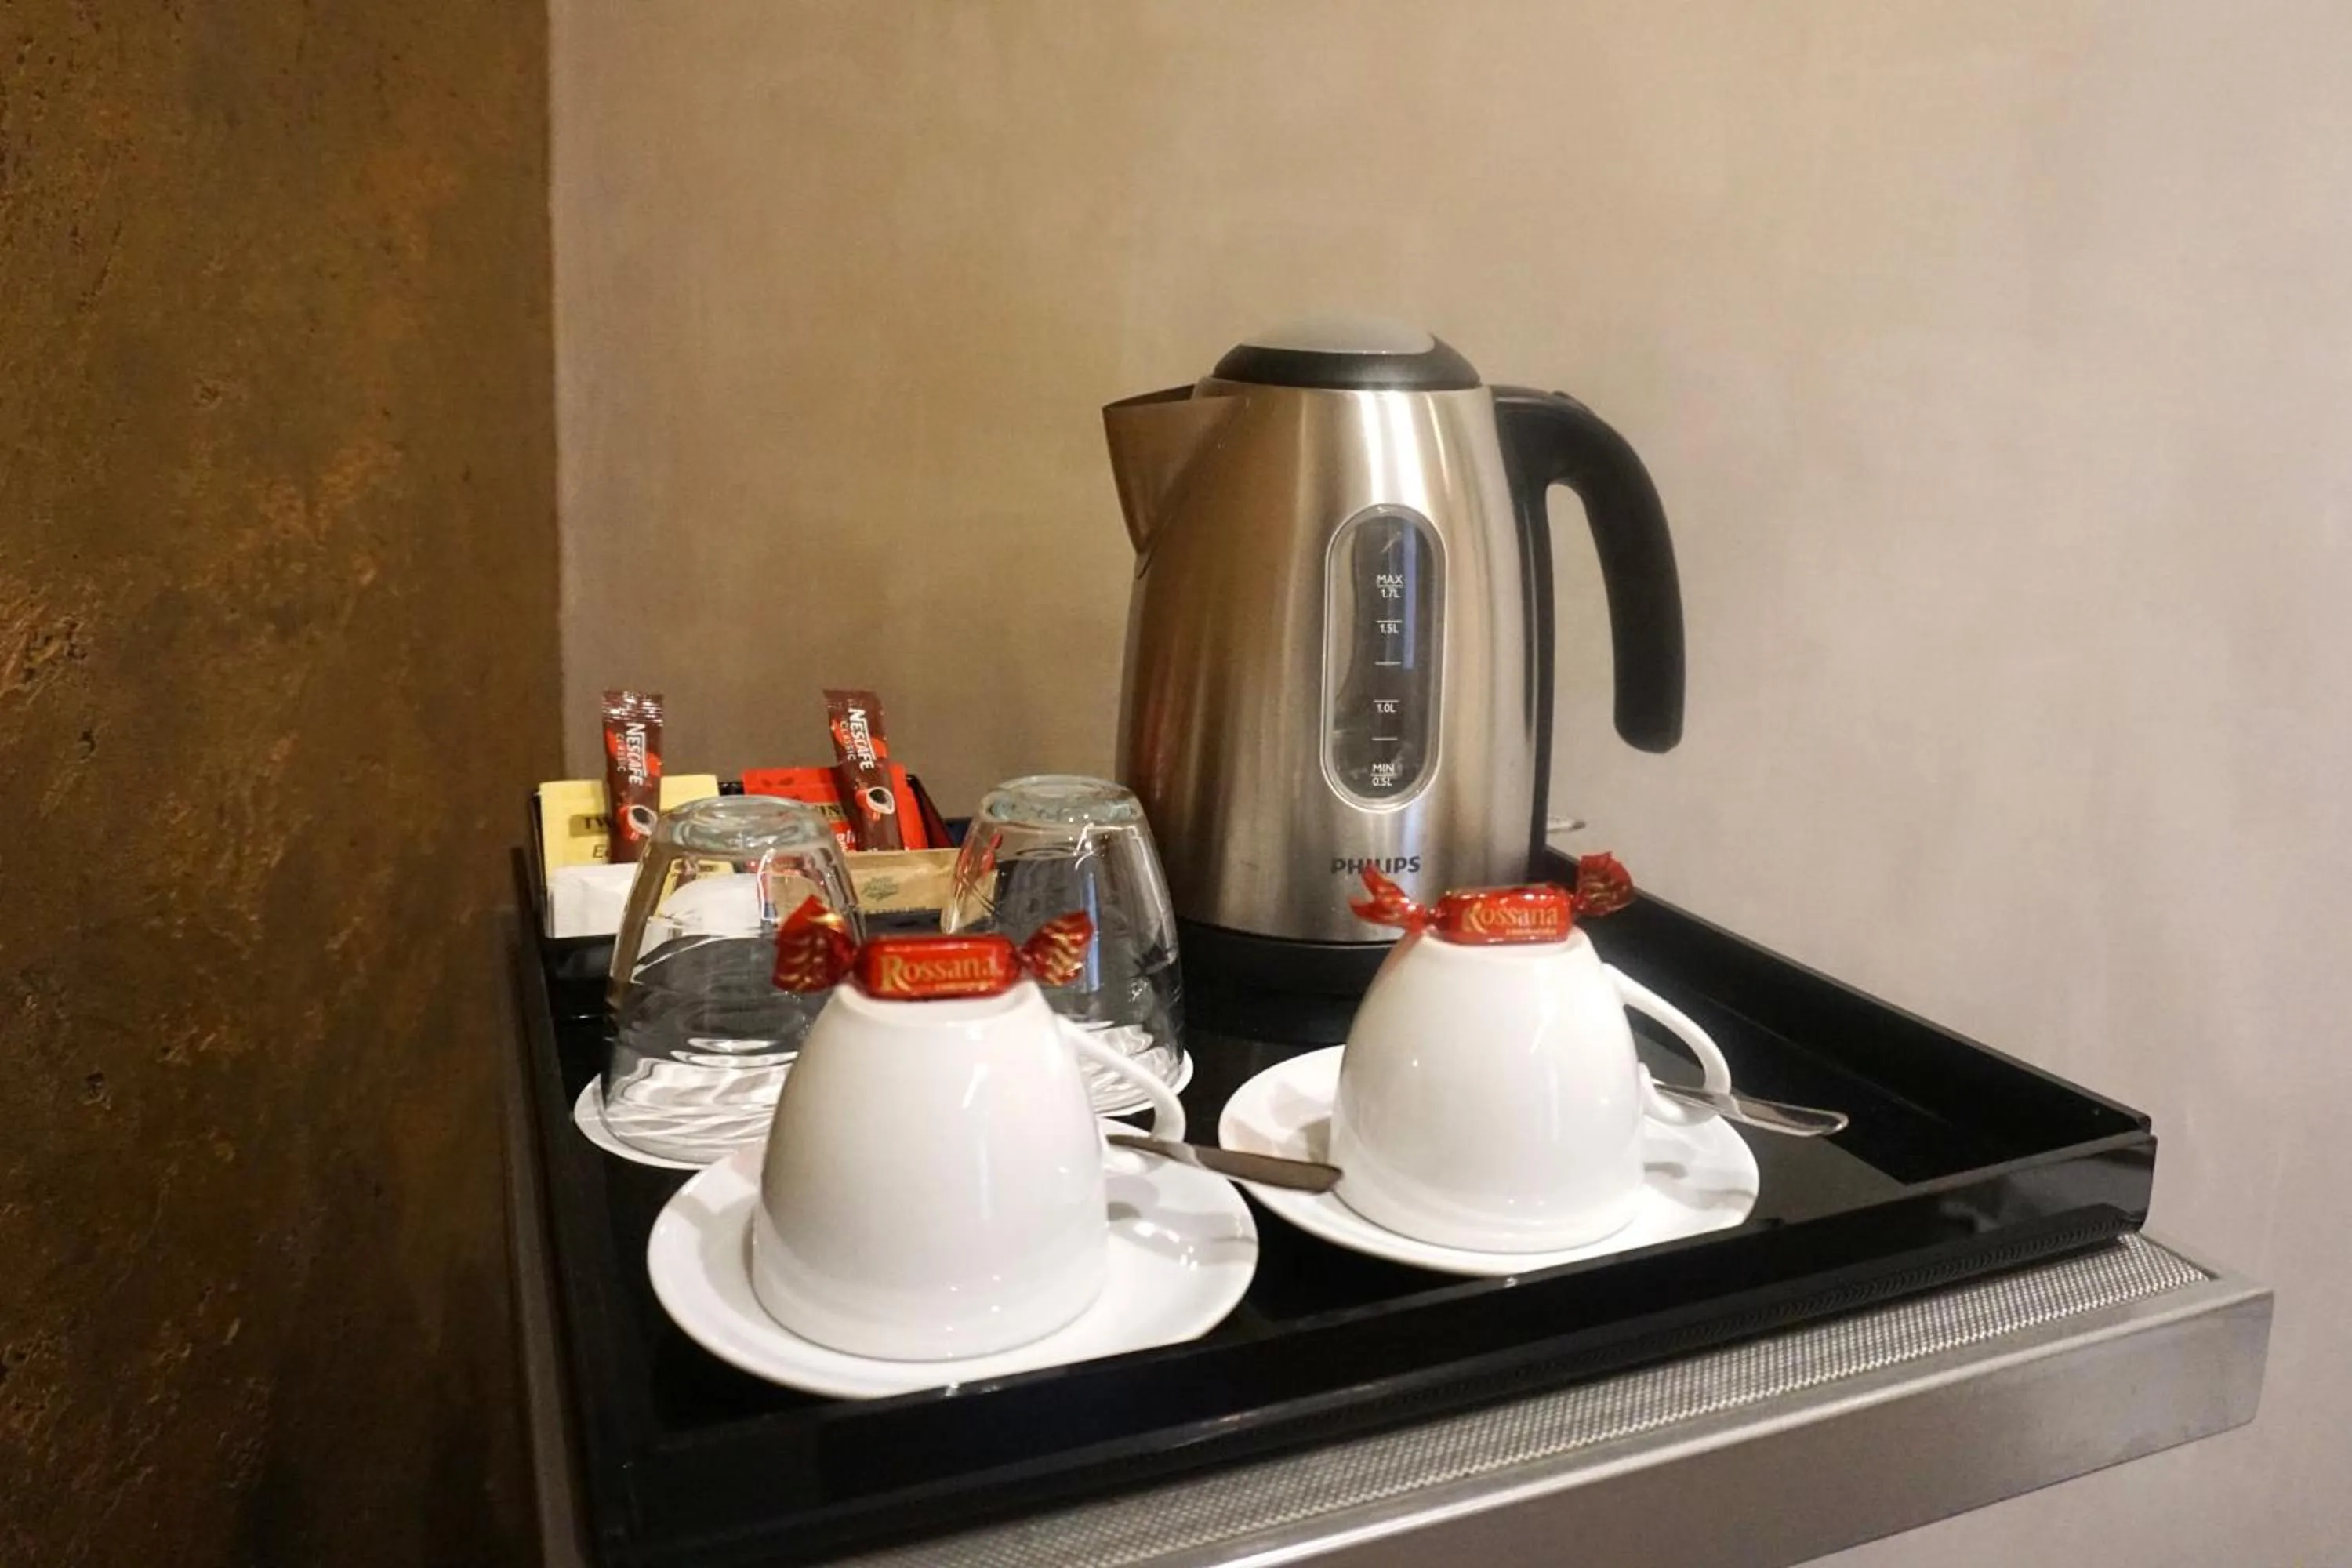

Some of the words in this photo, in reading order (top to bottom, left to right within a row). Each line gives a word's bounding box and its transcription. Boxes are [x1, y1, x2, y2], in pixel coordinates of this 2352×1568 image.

[1377, 574, 1403, 585] MAX
[1381, 589, 1399, 598] 1.7L
[1380, 623, 1399, 634] 1.5L
[1377, 703, 1396, 713] 1.0L
[1373, 763, 1395, 773] MIN
[1372, 777, 1393, 786] 0.5L
